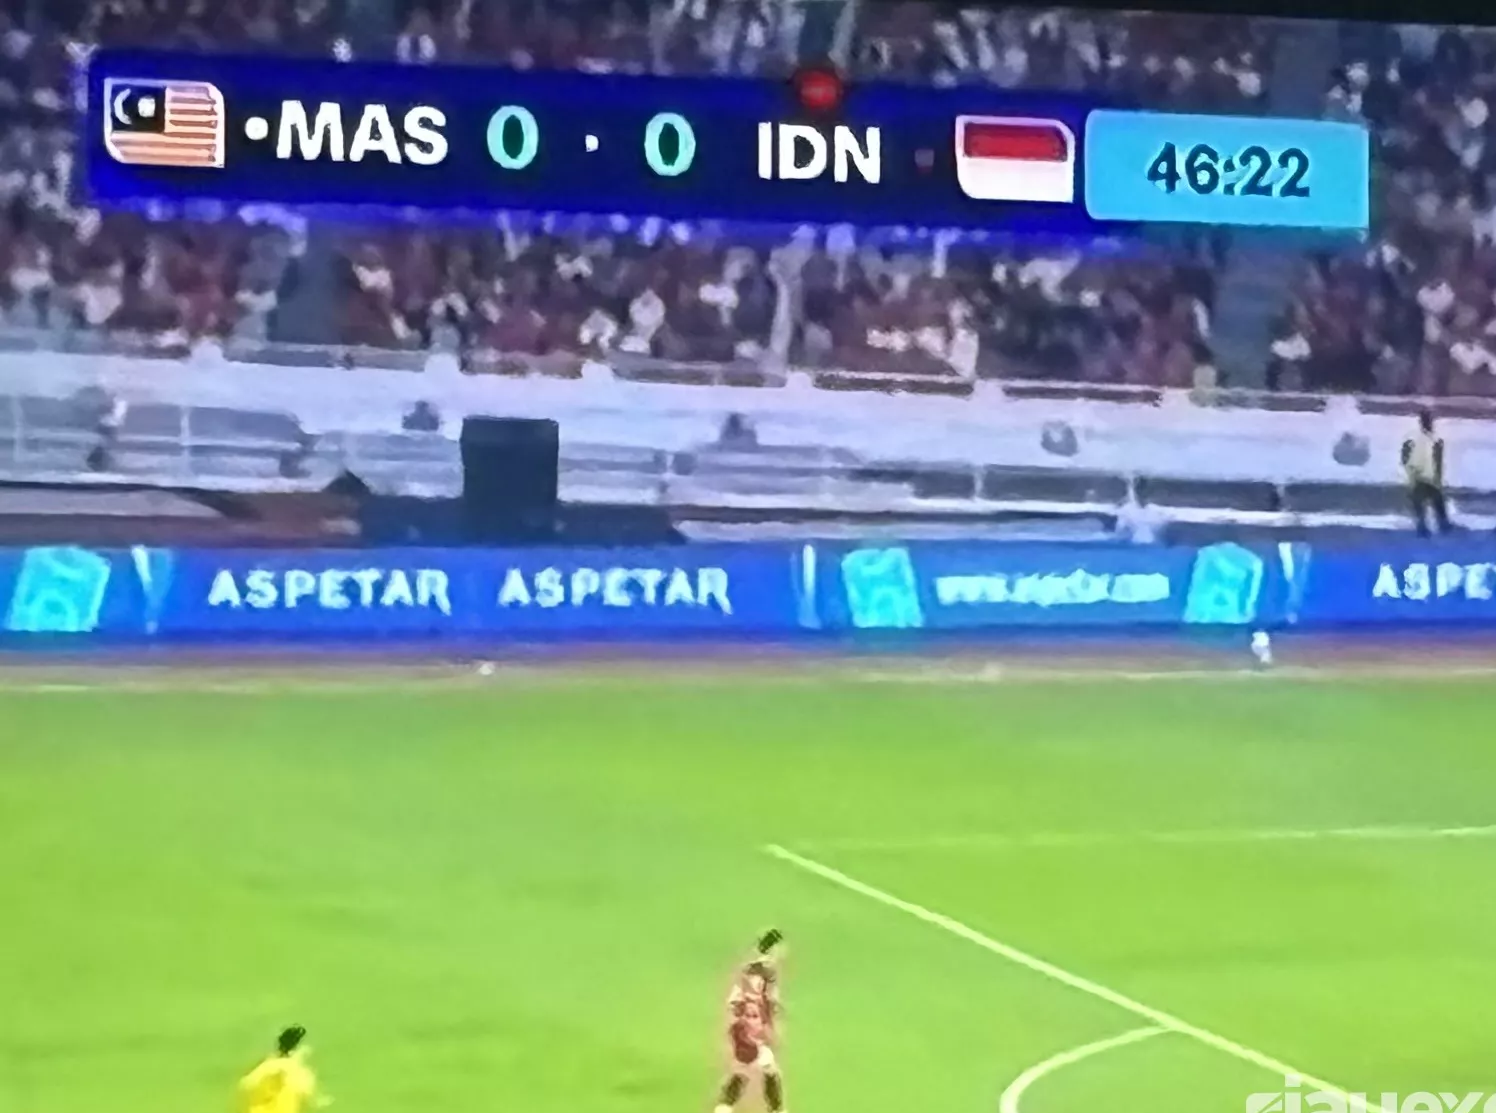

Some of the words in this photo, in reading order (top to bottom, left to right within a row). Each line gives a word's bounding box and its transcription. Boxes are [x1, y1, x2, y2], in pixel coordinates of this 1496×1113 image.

[276, 99, 449, 166] MAS
[486, 104, 539, 170] 0
[643, 111, 696, 177] 0
[758, 121, 881, 184] IDN
[1146, 141, 1311, 198] 46:22
[207, 567, 451, 615] ASPETAR
[499, 566, 733, 615] ASPETAR
